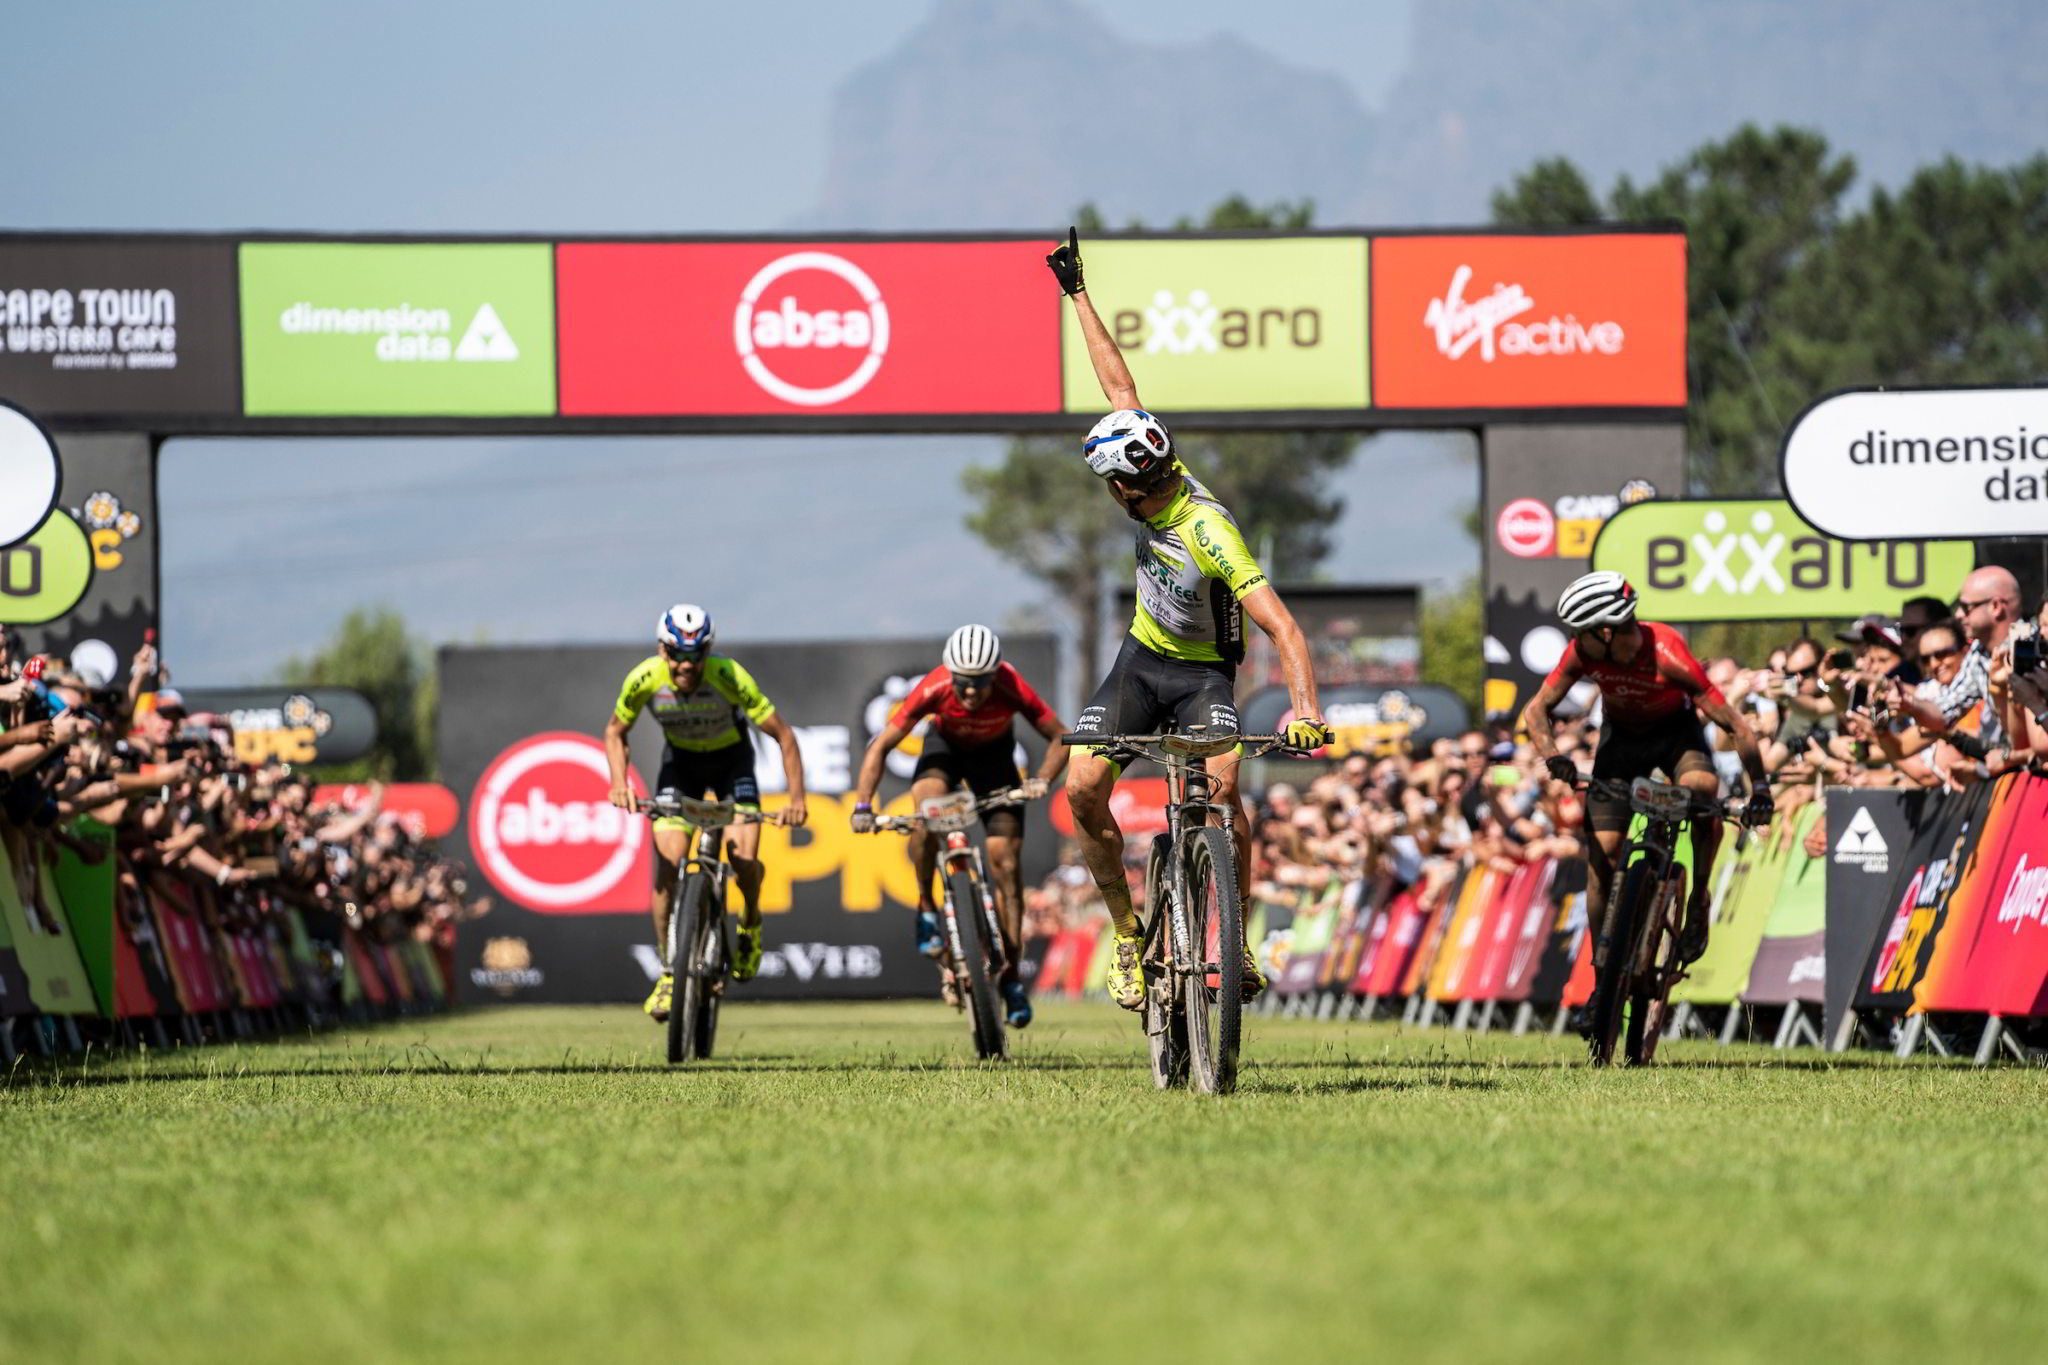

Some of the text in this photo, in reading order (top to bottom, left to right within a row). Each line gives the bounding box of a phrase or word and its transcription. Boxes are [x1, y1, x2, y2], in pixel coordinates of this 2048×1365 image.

[78, 288, 175, 326] TOWN
[280, 302, 450, 333] dimension
[752, 297, 870, 348] absa
[1115, 290, 1320, 353] exxaro
[1424, 264, 1534, 362] Virgin
[376, 331, 451, 362] data
[1500, 313, 1624, 355] active
[1207, 543, 1236, 580] STEEL
[1648, 510, 1925, 594] exxaro
[1158, 566, 1203, 602] STEEL
[1075, 723, 1099, 732] STEEL
[1211, 711, 1238, 722] EURO
[1211, 718, 1238, 728] STEEL
[501, 788, 622, 846] absa
[1171, 902, 1190, 949] ROCKSHO
